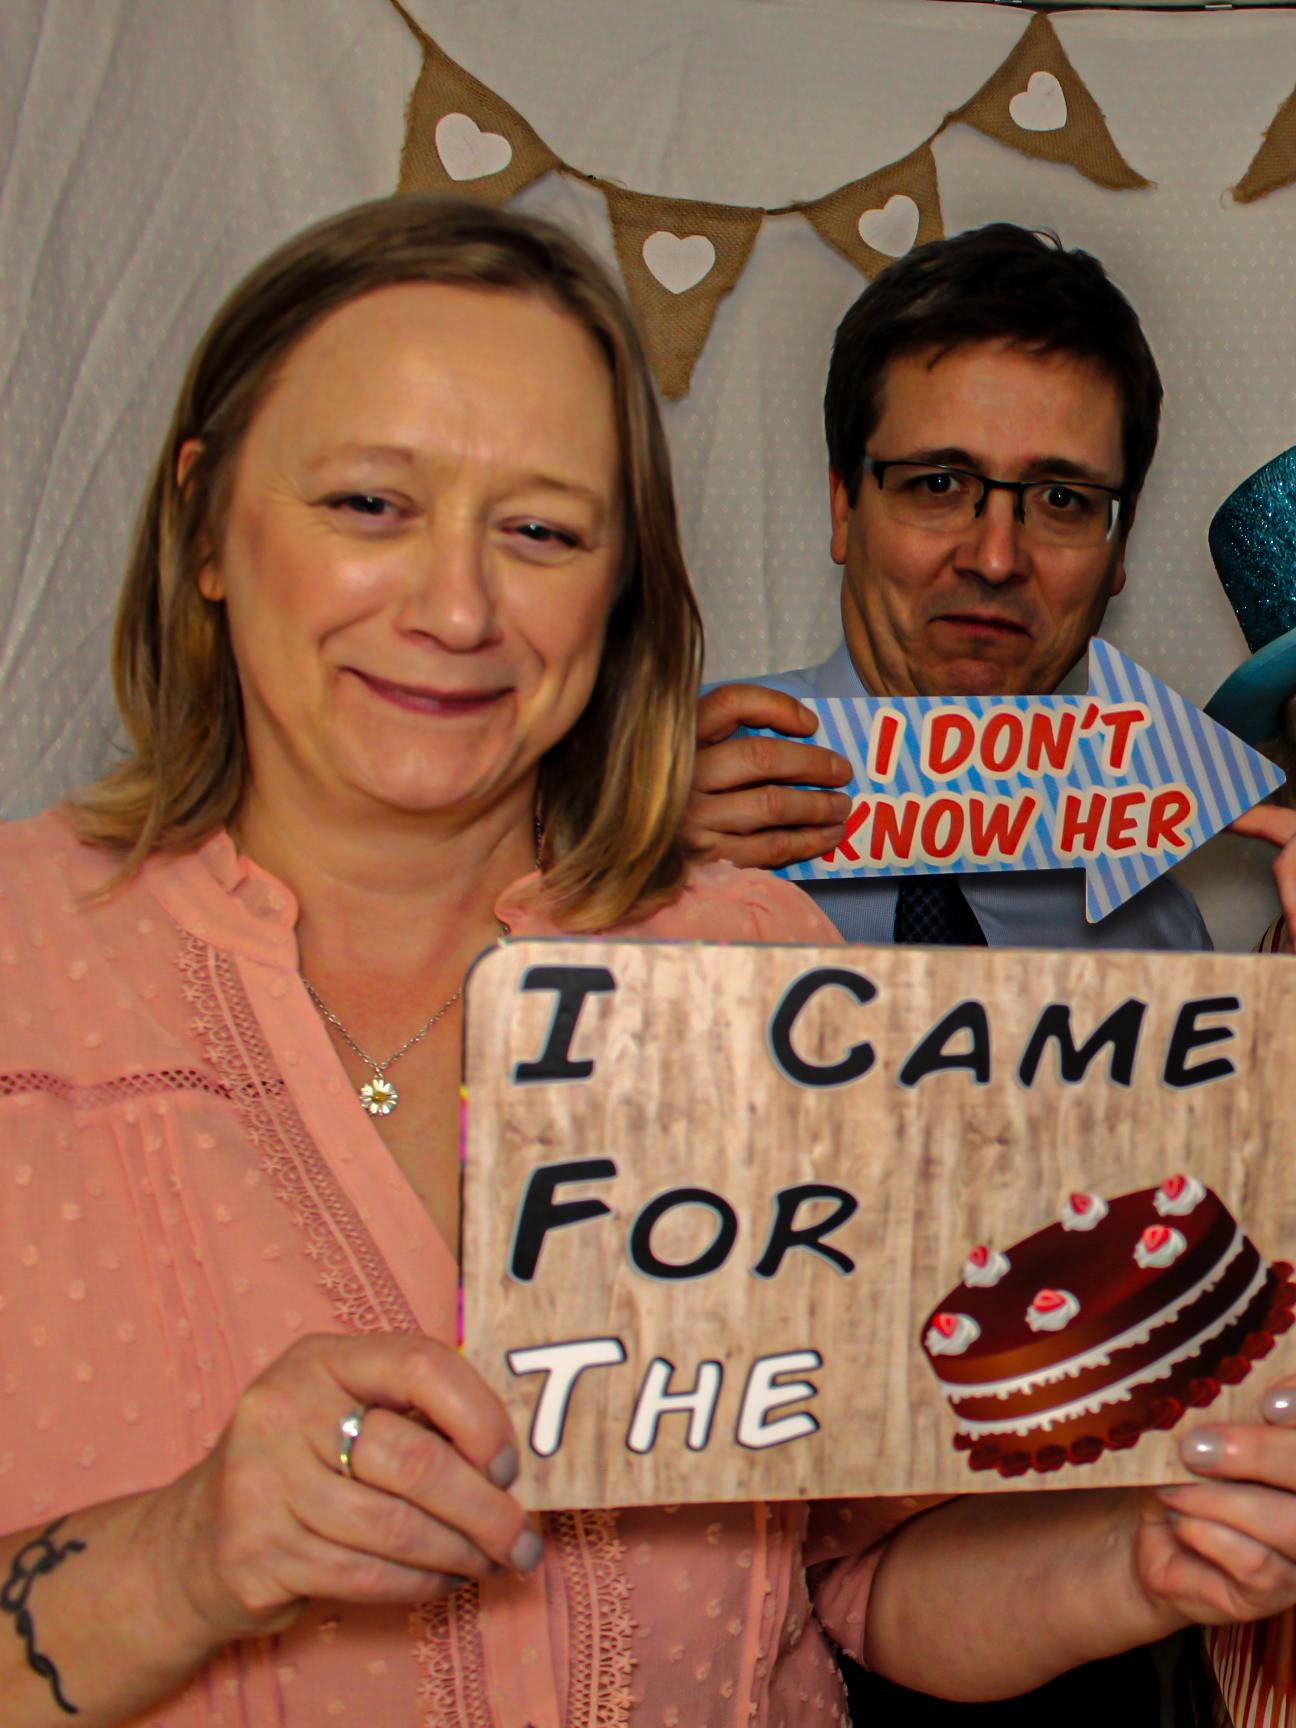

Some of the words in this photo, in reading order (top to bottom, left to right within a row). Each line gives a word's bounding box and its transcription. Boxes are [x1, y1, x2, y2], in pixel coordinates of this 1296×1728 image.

[870, 711, 902, 779] I
[926, 702, 1147, 776] DON'T
[1058, 789, 1193, 854] HER
[512, 965, 617, 1086] I
[768, 966, 1242, 1089] CAME
[508, 1159, 858, 1282] FOR
[506, 1337, 823, 1458] THE
